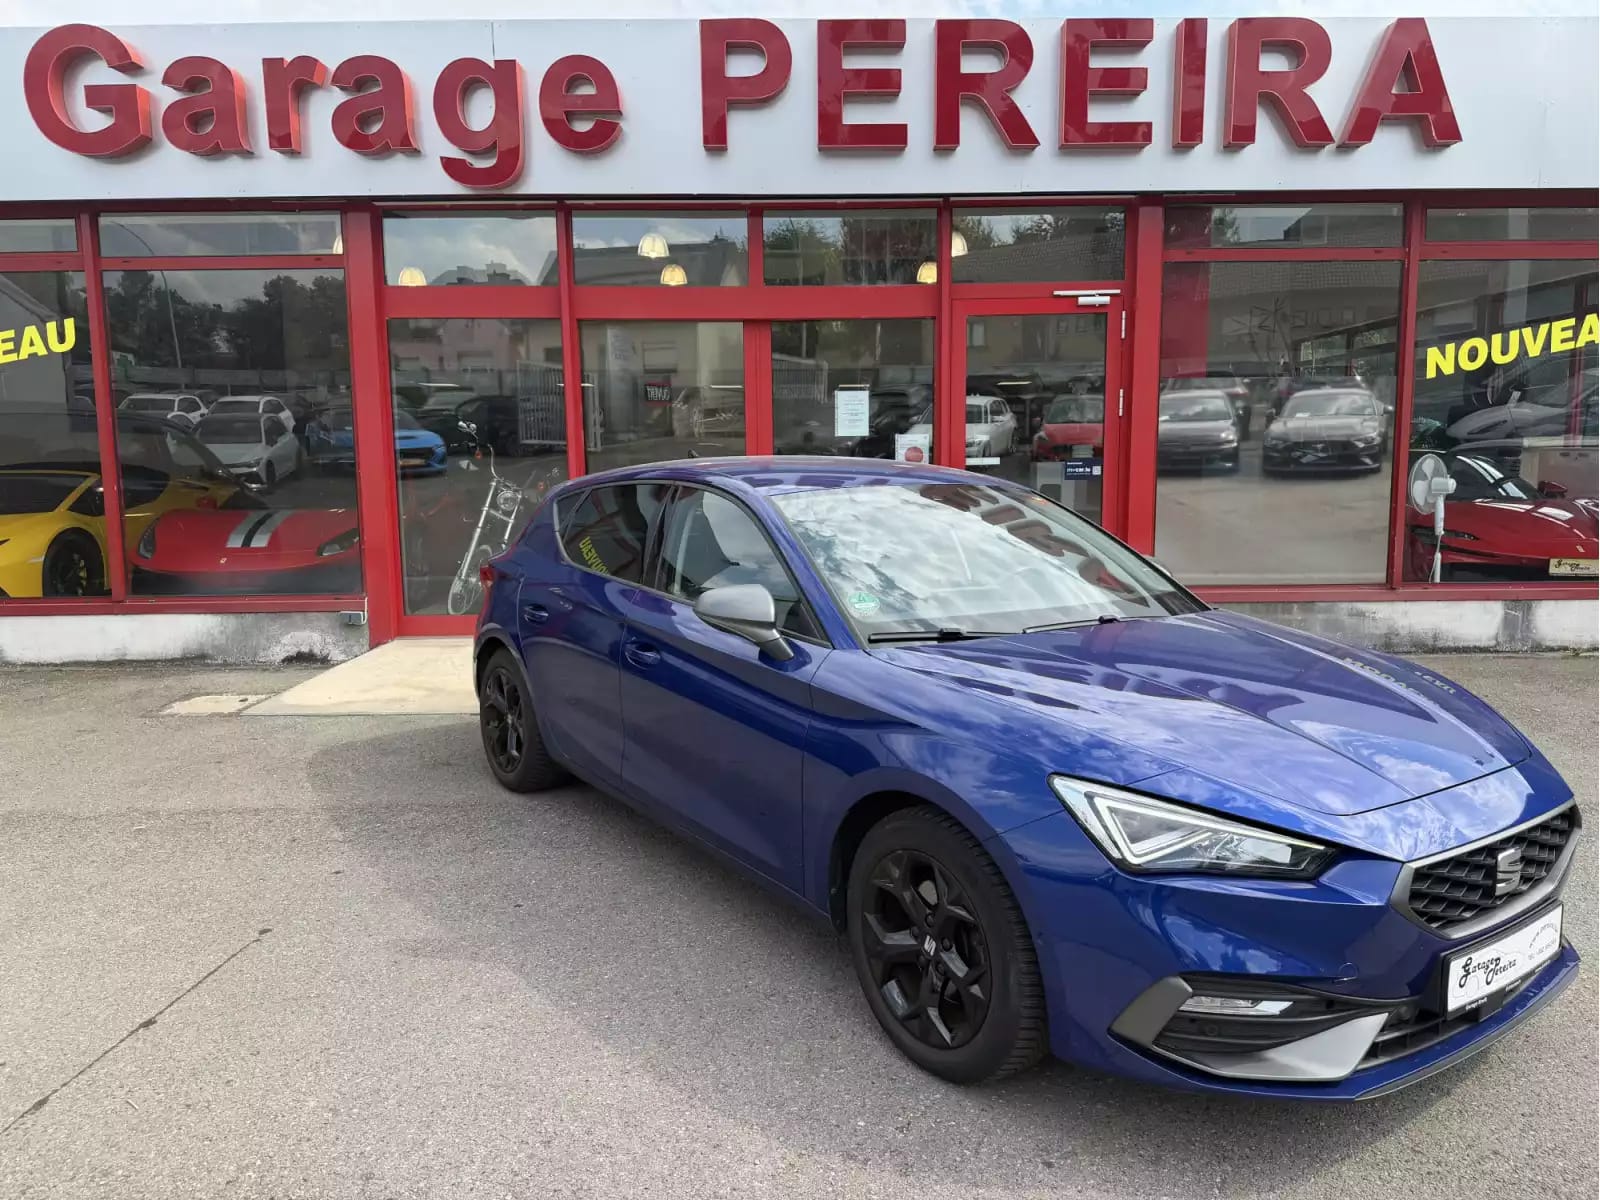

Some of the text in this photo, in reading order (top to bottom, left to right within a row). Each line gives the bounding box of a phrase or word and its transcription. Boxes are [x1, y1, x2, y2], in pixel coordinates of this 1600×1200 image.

[23, 17, 1463, 190] Garage PEREIRA
[1458, 956, 1496, 989] Garage
